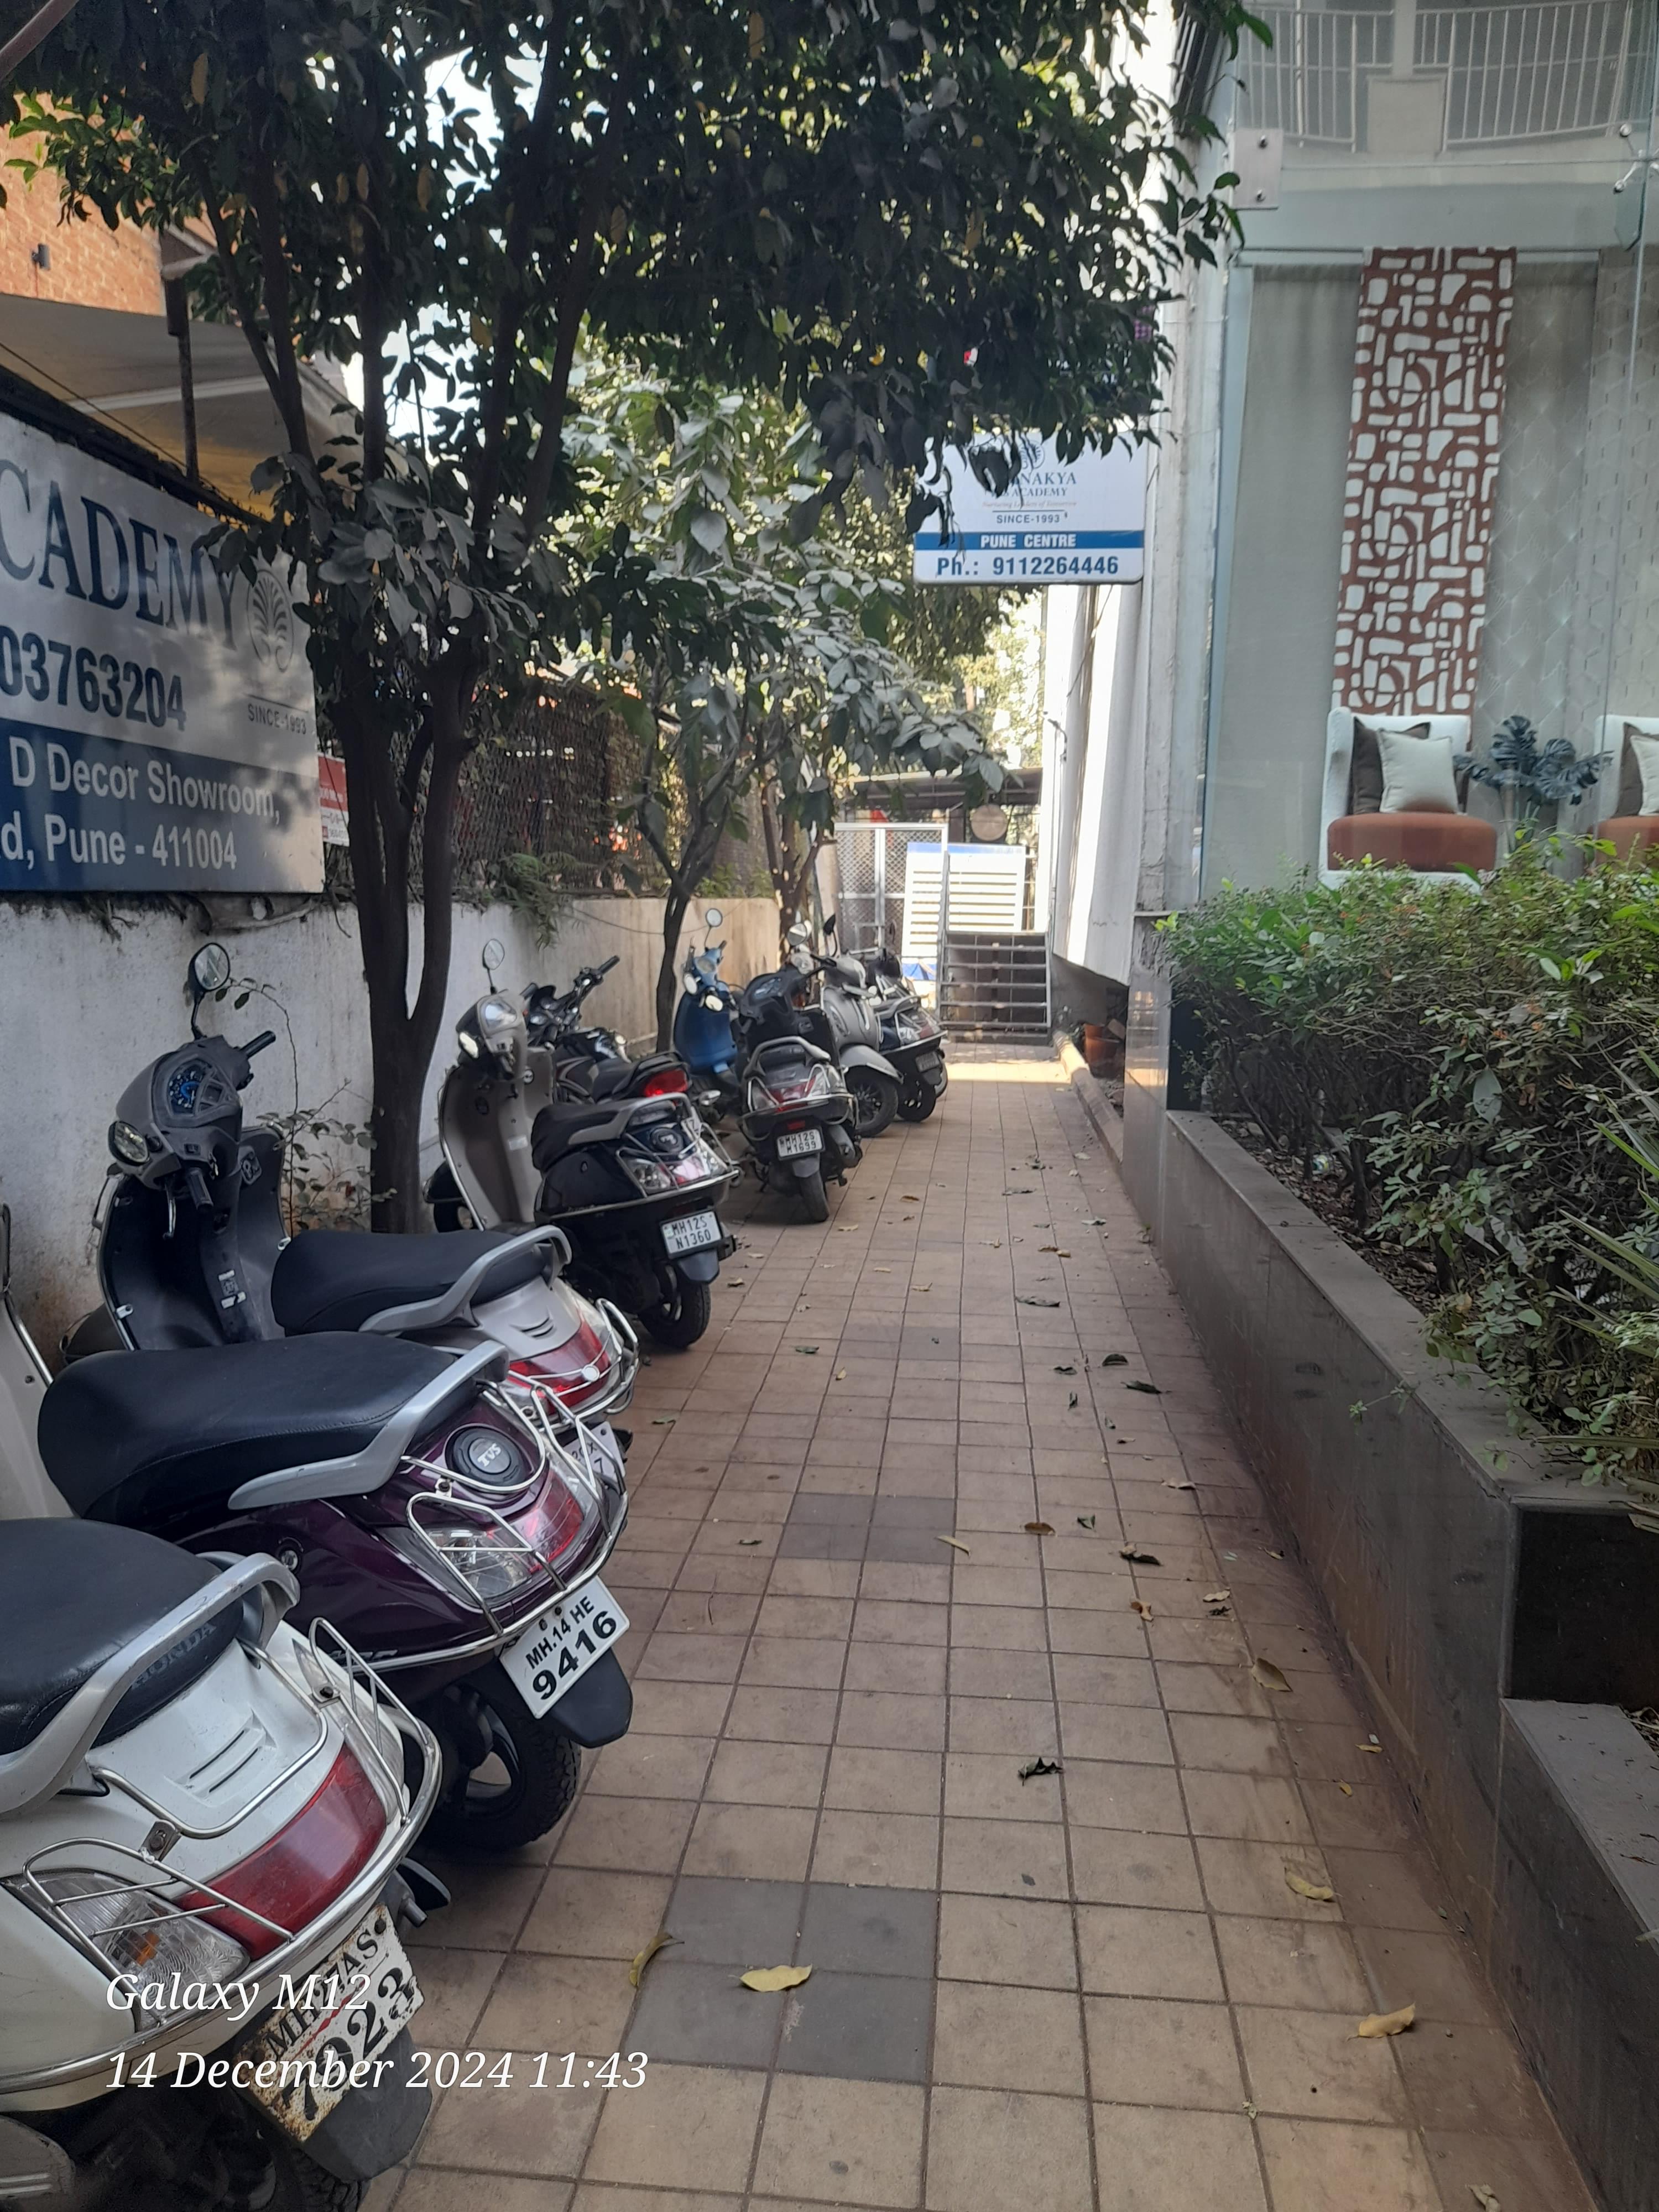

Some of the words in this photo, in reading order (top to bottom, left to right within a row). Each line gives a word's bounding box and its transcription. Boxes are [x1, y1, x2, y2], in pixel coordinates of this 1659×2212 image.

[997, 514, 1060, 524] SINCE-1993
[980, 534, 1016, 549] PUNE
[1024, 534, 1077, 548] CENTRE
[937, 557, 978, 576] Ph.:
[993, 556, 1119, 575] 9112264446
[0, 625, 186, 732] 03763204
[248, 704, 307, 735] SINCE-1993
[9, 735, 35, 787] D
[47, 743, 139, 800] Decor
[147, 760, 280, 825] Showroom,
[44, 813, 126, 865] Pune
[135, 844, 145, 855] -
[152, 824, 237, 870] 411004
[671, 1216, 708, 1235] MH12S
[675, 1229, 711, 1249] N1360
[477, 1443, 502, 1467] TVS
[525, 1618, 571, 1670] MH.14
[570, 1596, 594, 1624] HE
[533, 1611, 617, 1700] 9416
